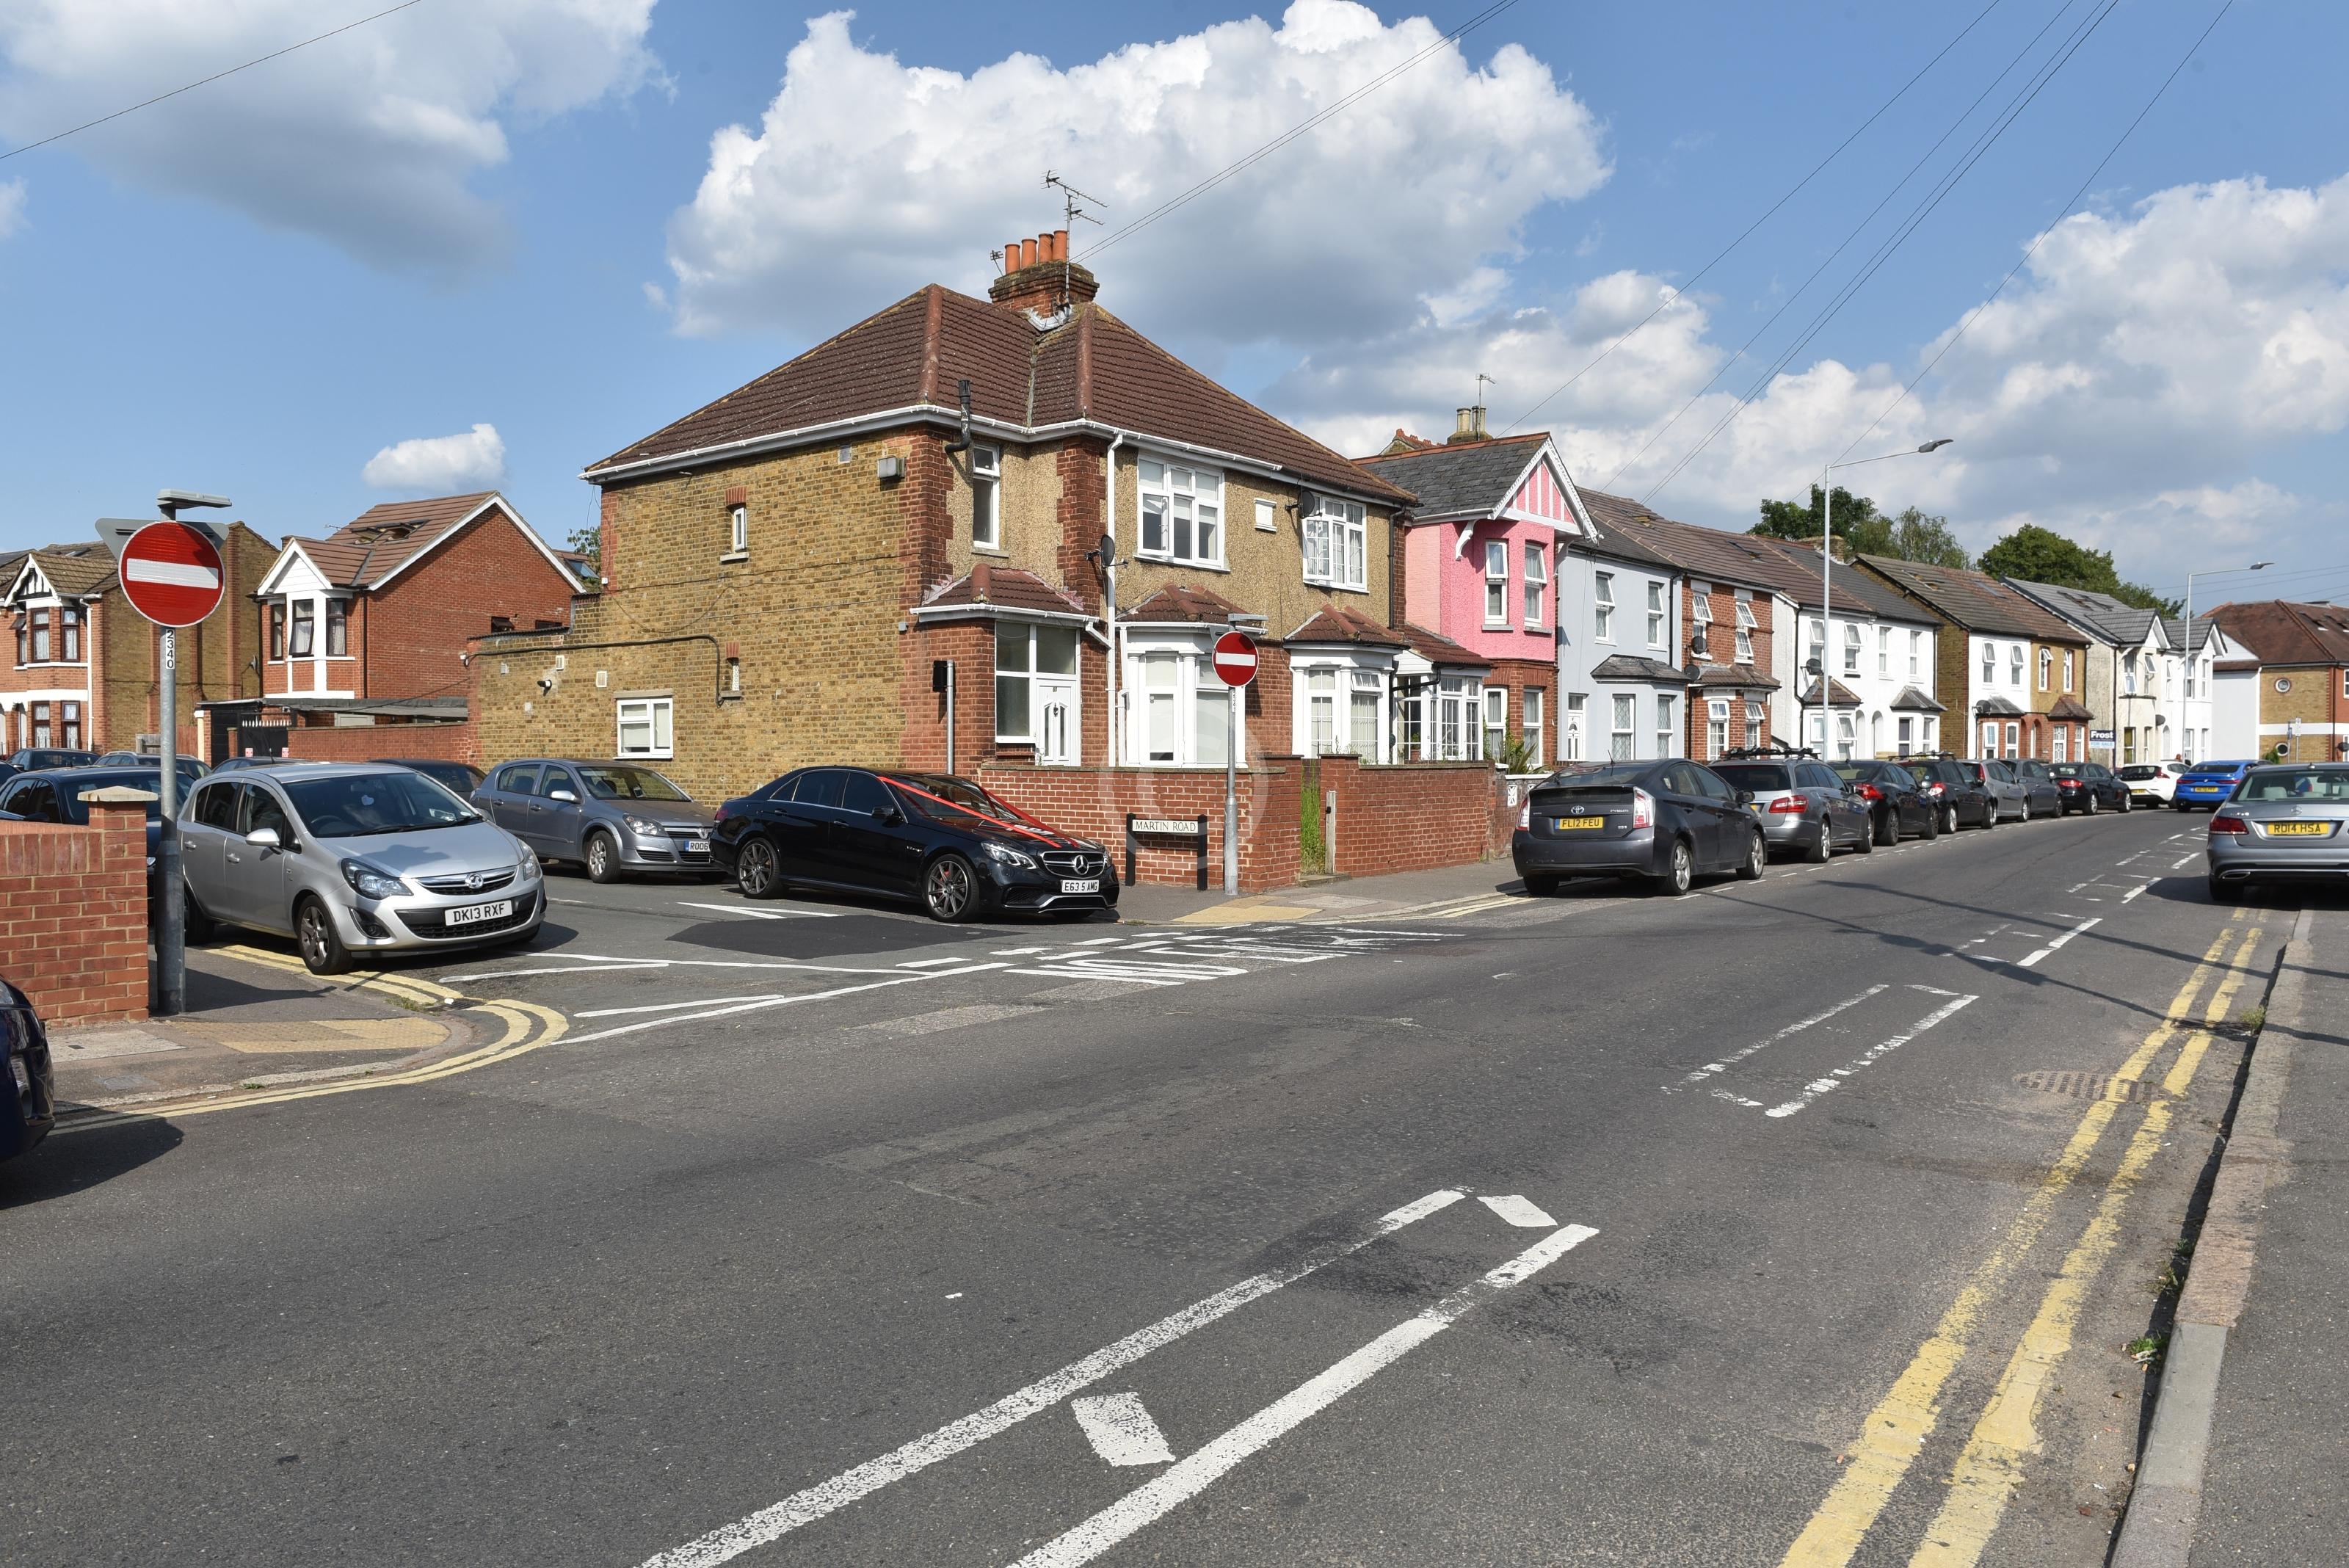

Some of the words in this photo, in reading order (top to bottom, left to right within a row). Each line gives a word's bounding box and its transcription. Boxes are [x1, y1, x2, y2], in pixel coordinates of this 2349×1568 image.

[2091, 730, 2113, 738] Frost
[1135, 821, 1169, 831] MARTIN
[1172, 821, 1197, 832] ROAD
[1562, 819, 1580, 828] FL12
[1583, 818, 1600, 827] FEU
[2273, 823, 2297, 832] RD14
[2300, 823, 2321, 832] HSA
[453, 907, 481, 923] DK13
[484, 902, 505, 918] RXF
[1001, 959, 1249, 985] NO
